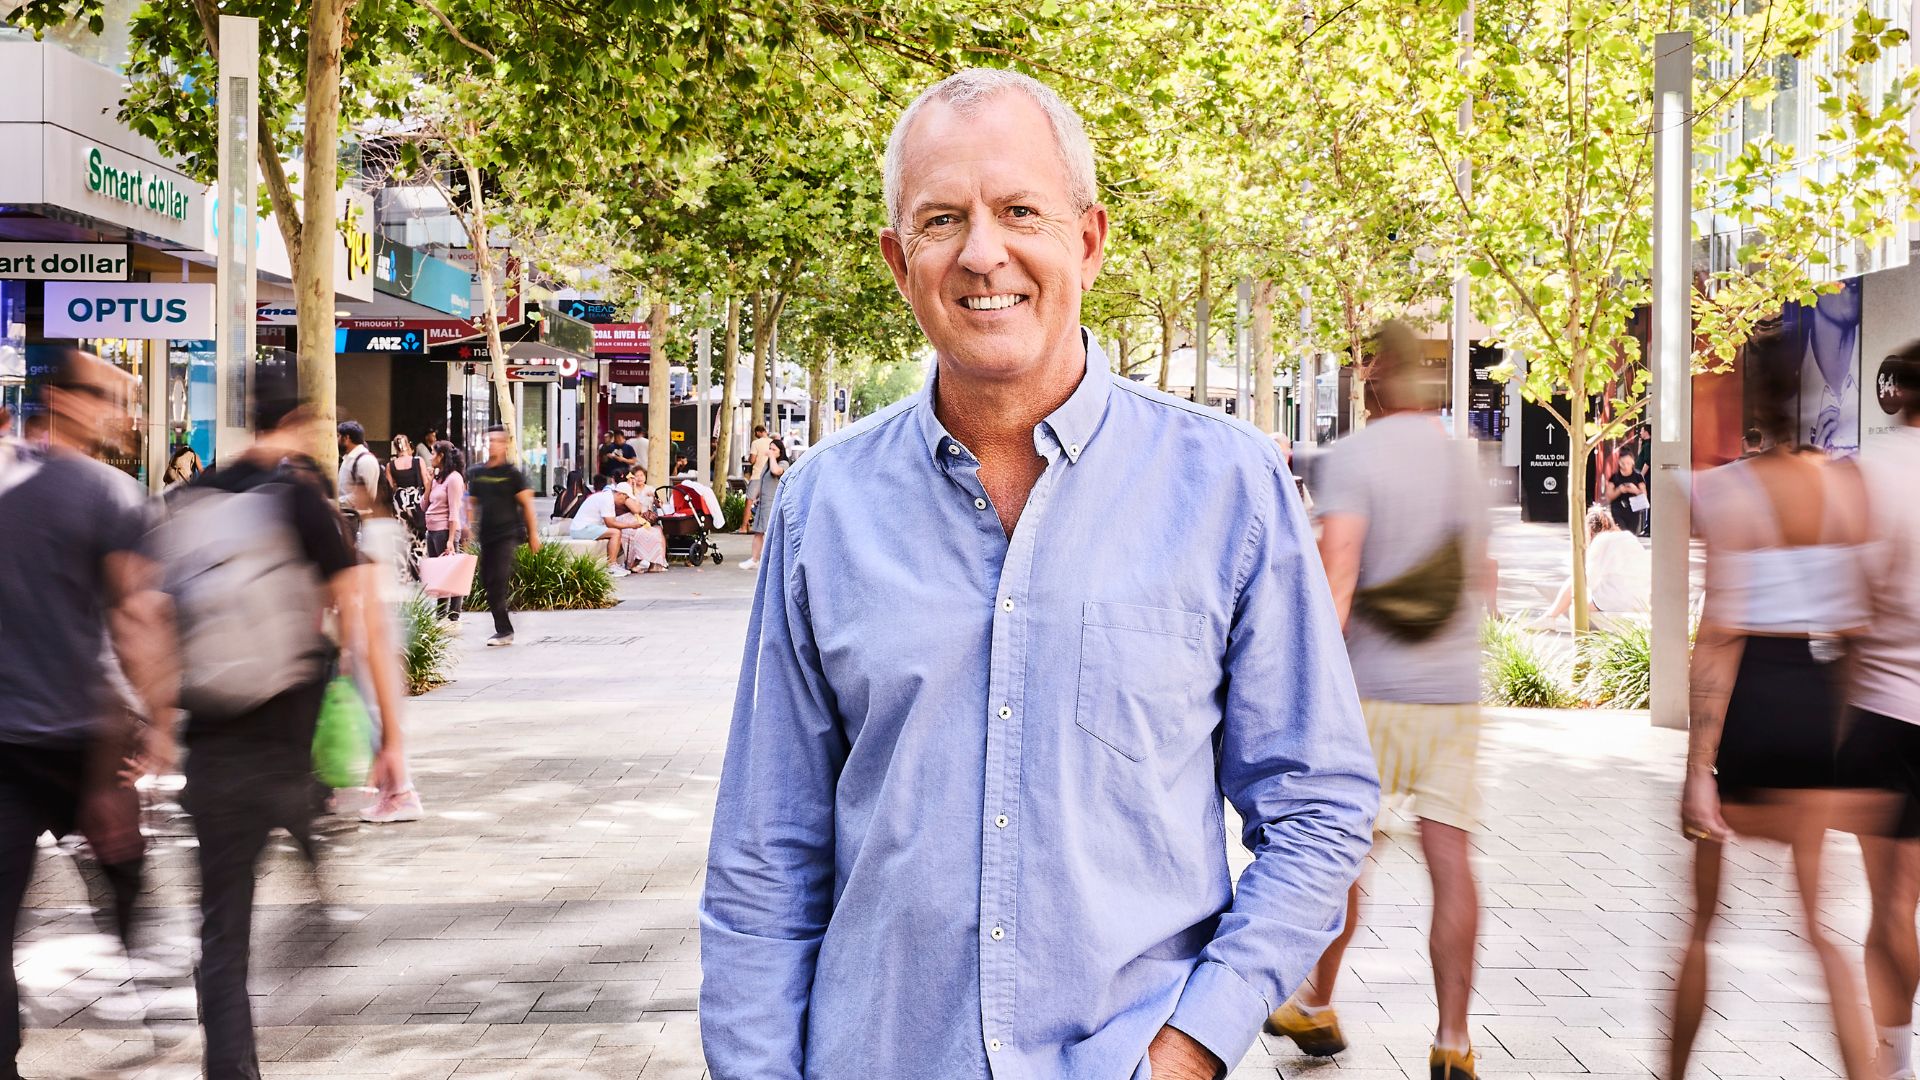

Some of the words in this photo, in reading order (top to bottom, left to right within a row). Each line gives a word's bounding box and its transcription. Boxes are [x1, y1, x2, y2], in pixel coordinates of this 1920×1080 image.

[88, 147, 143, 206] Smart
[148, 175, 189, 220] dollar
[0, 254, 36, 273] art
[41, 254, 126, 273] dollar
[67, 297, 188, 323] OPTUS
[588, 305, 615, 313] READ
[354, 320, 393, 328] THROUGH
[394, 320, 405, 328] TO
[430, 328, 463, 338] MALL
[595, 330, 612, 340] COAL
[613, 330, 636, 340] RIVER
[366, 336, 402, 351] ANZ
[617, 419, 641, 428] Mobile
